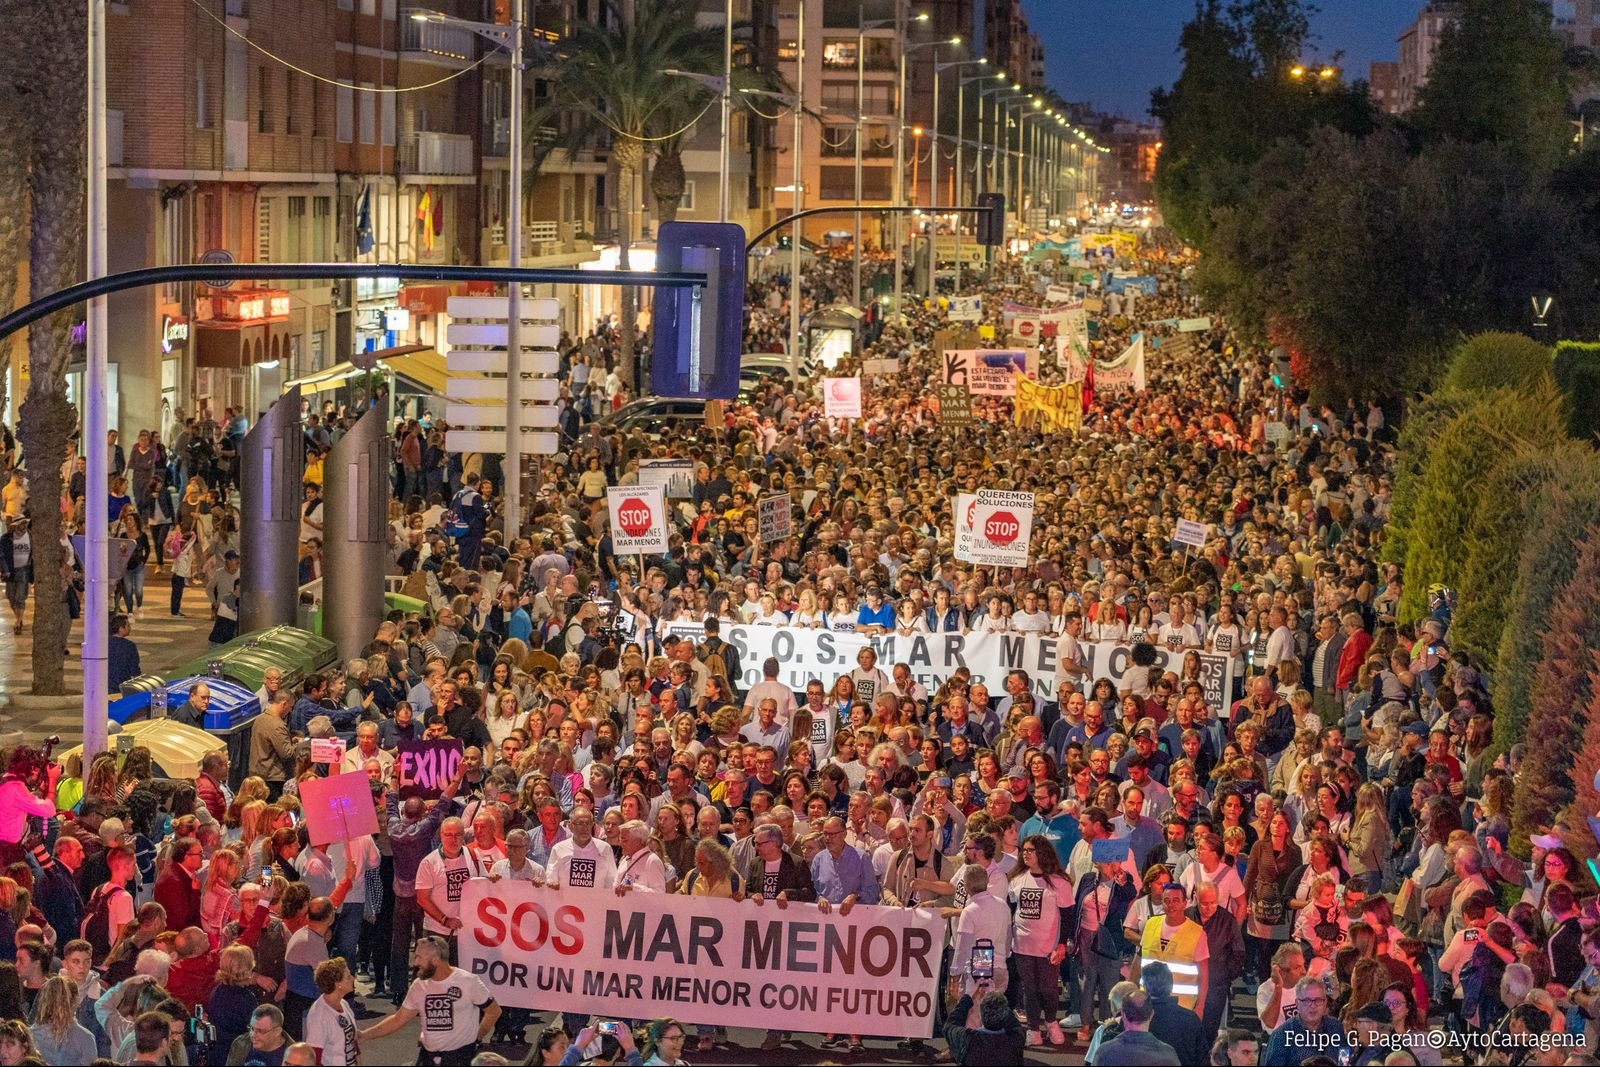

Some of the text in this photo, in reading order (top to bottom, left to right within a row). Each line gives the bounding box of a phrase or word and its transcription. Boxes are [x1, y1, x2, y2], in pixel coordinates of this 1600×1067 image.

[940, 386, 966, 398] SOS
[941, 399, 967, 408] MAR
[942, 409, 971, 418] MENOR
[978, 490, 1033, 501] QUEREMOS
[976, 498, 1033, 509] SOLUCIONES
[620, 509, 650, 526] STOP
[614, 527, 662, 538] INUNDACIONES
[986, 521, 1018, 537] STOP
[616, 538, 661, 547] MAR MENOR
[973, 538, 1026, 552] INUNDACIONES
[870, 634, 967, 667] MAR
[858, 682, 875, 690] SOS
[812, 722, 825, 730] OS
[400, 748, 462, 791] EXIJO
[572, 863, 594, 872] SOS
[448, 872, 469, 883] SOS
[572, 872, 593, 880] MAR
[571, 879, 593, 887] MENOR
[1021, 891, 1041, 900] SOS
[1021, 900, 1040, 908] MAR
[473, 896, 934, 979] SOS MAR MENOR
[472, 957, 932, 1019] POR UN MAR MENOR CON FUTURO
[426, 998, 451, 1010] SOS
[427, 1009, 450, 1018] MAR
[427, 1017, 453, 1025] MENOR
